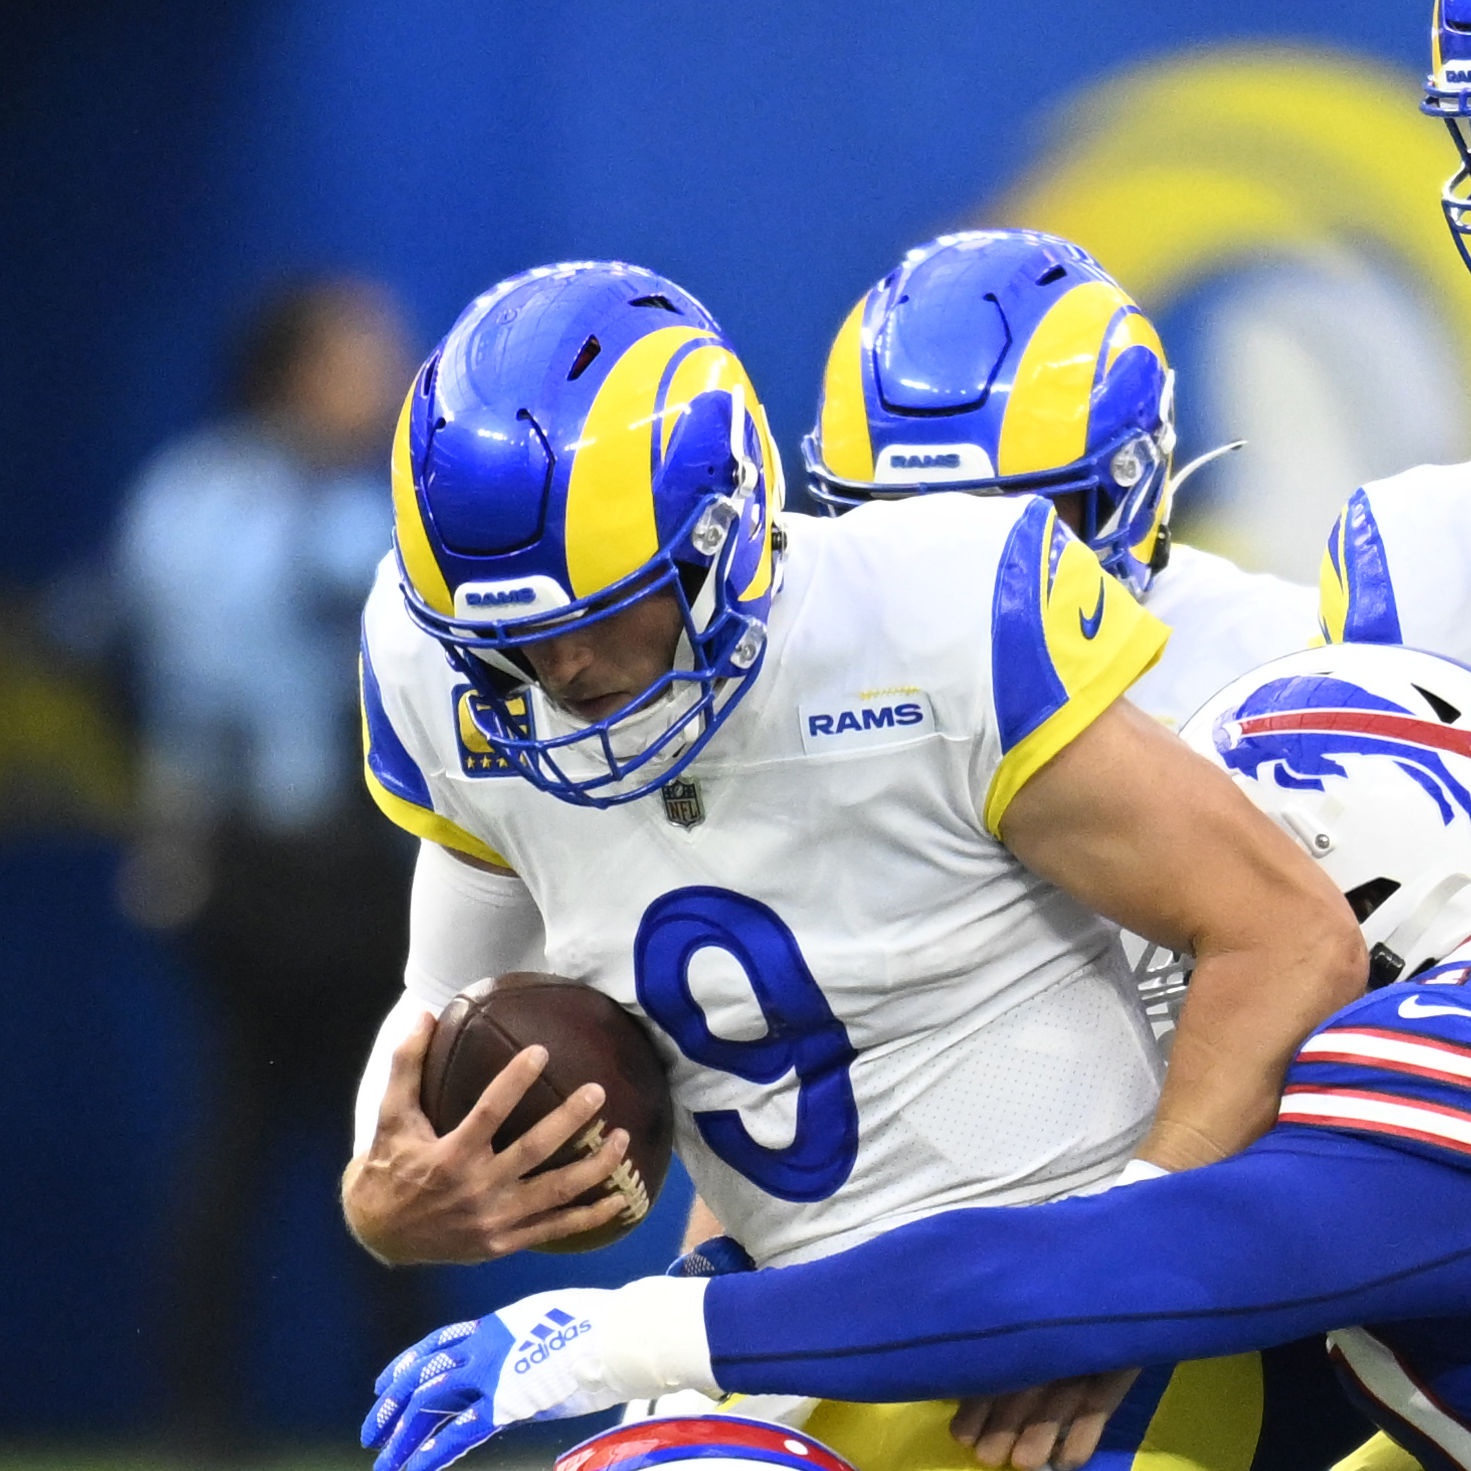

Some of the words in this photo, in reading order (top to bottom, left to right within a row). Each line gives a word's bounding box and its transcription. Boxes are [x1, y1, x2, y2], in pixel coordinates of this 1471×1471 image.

[890, 453, 960, 469] RAMS
[465, 587, 537, 606] RAMS
[809, 703, 923, 737] RAMS
[669, 800, 698, 820] NFL
[633, 885, 860, 1203] 9
[514, 1320, 592, 1374] adidas
